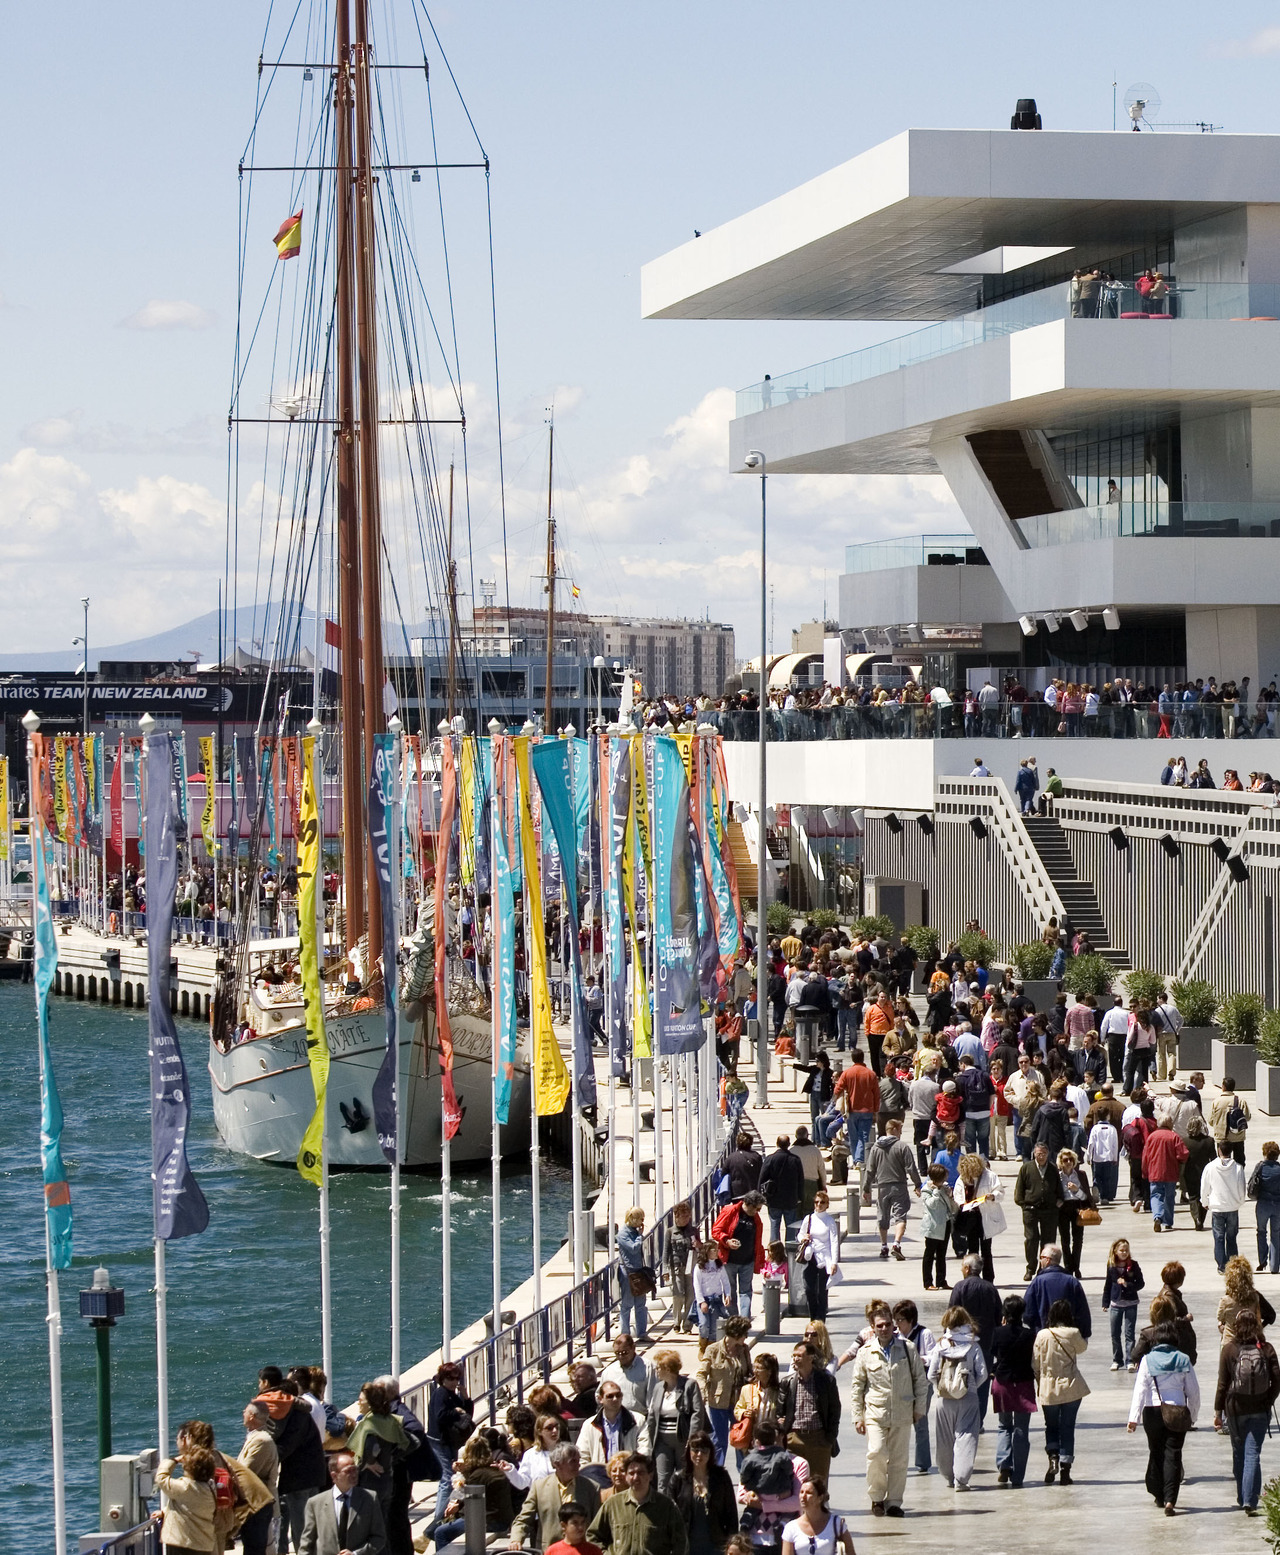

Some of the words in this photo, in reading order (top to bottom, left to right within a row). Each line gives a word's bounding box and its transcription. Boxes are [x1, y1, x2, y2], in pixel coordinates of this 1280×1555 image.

[43, 687, 90, 699] TEAM
[92, 687, 133, 699] NEW
[132, 687, 208, 699] ZEALAND
[657, 752, 665, 799] CUP
